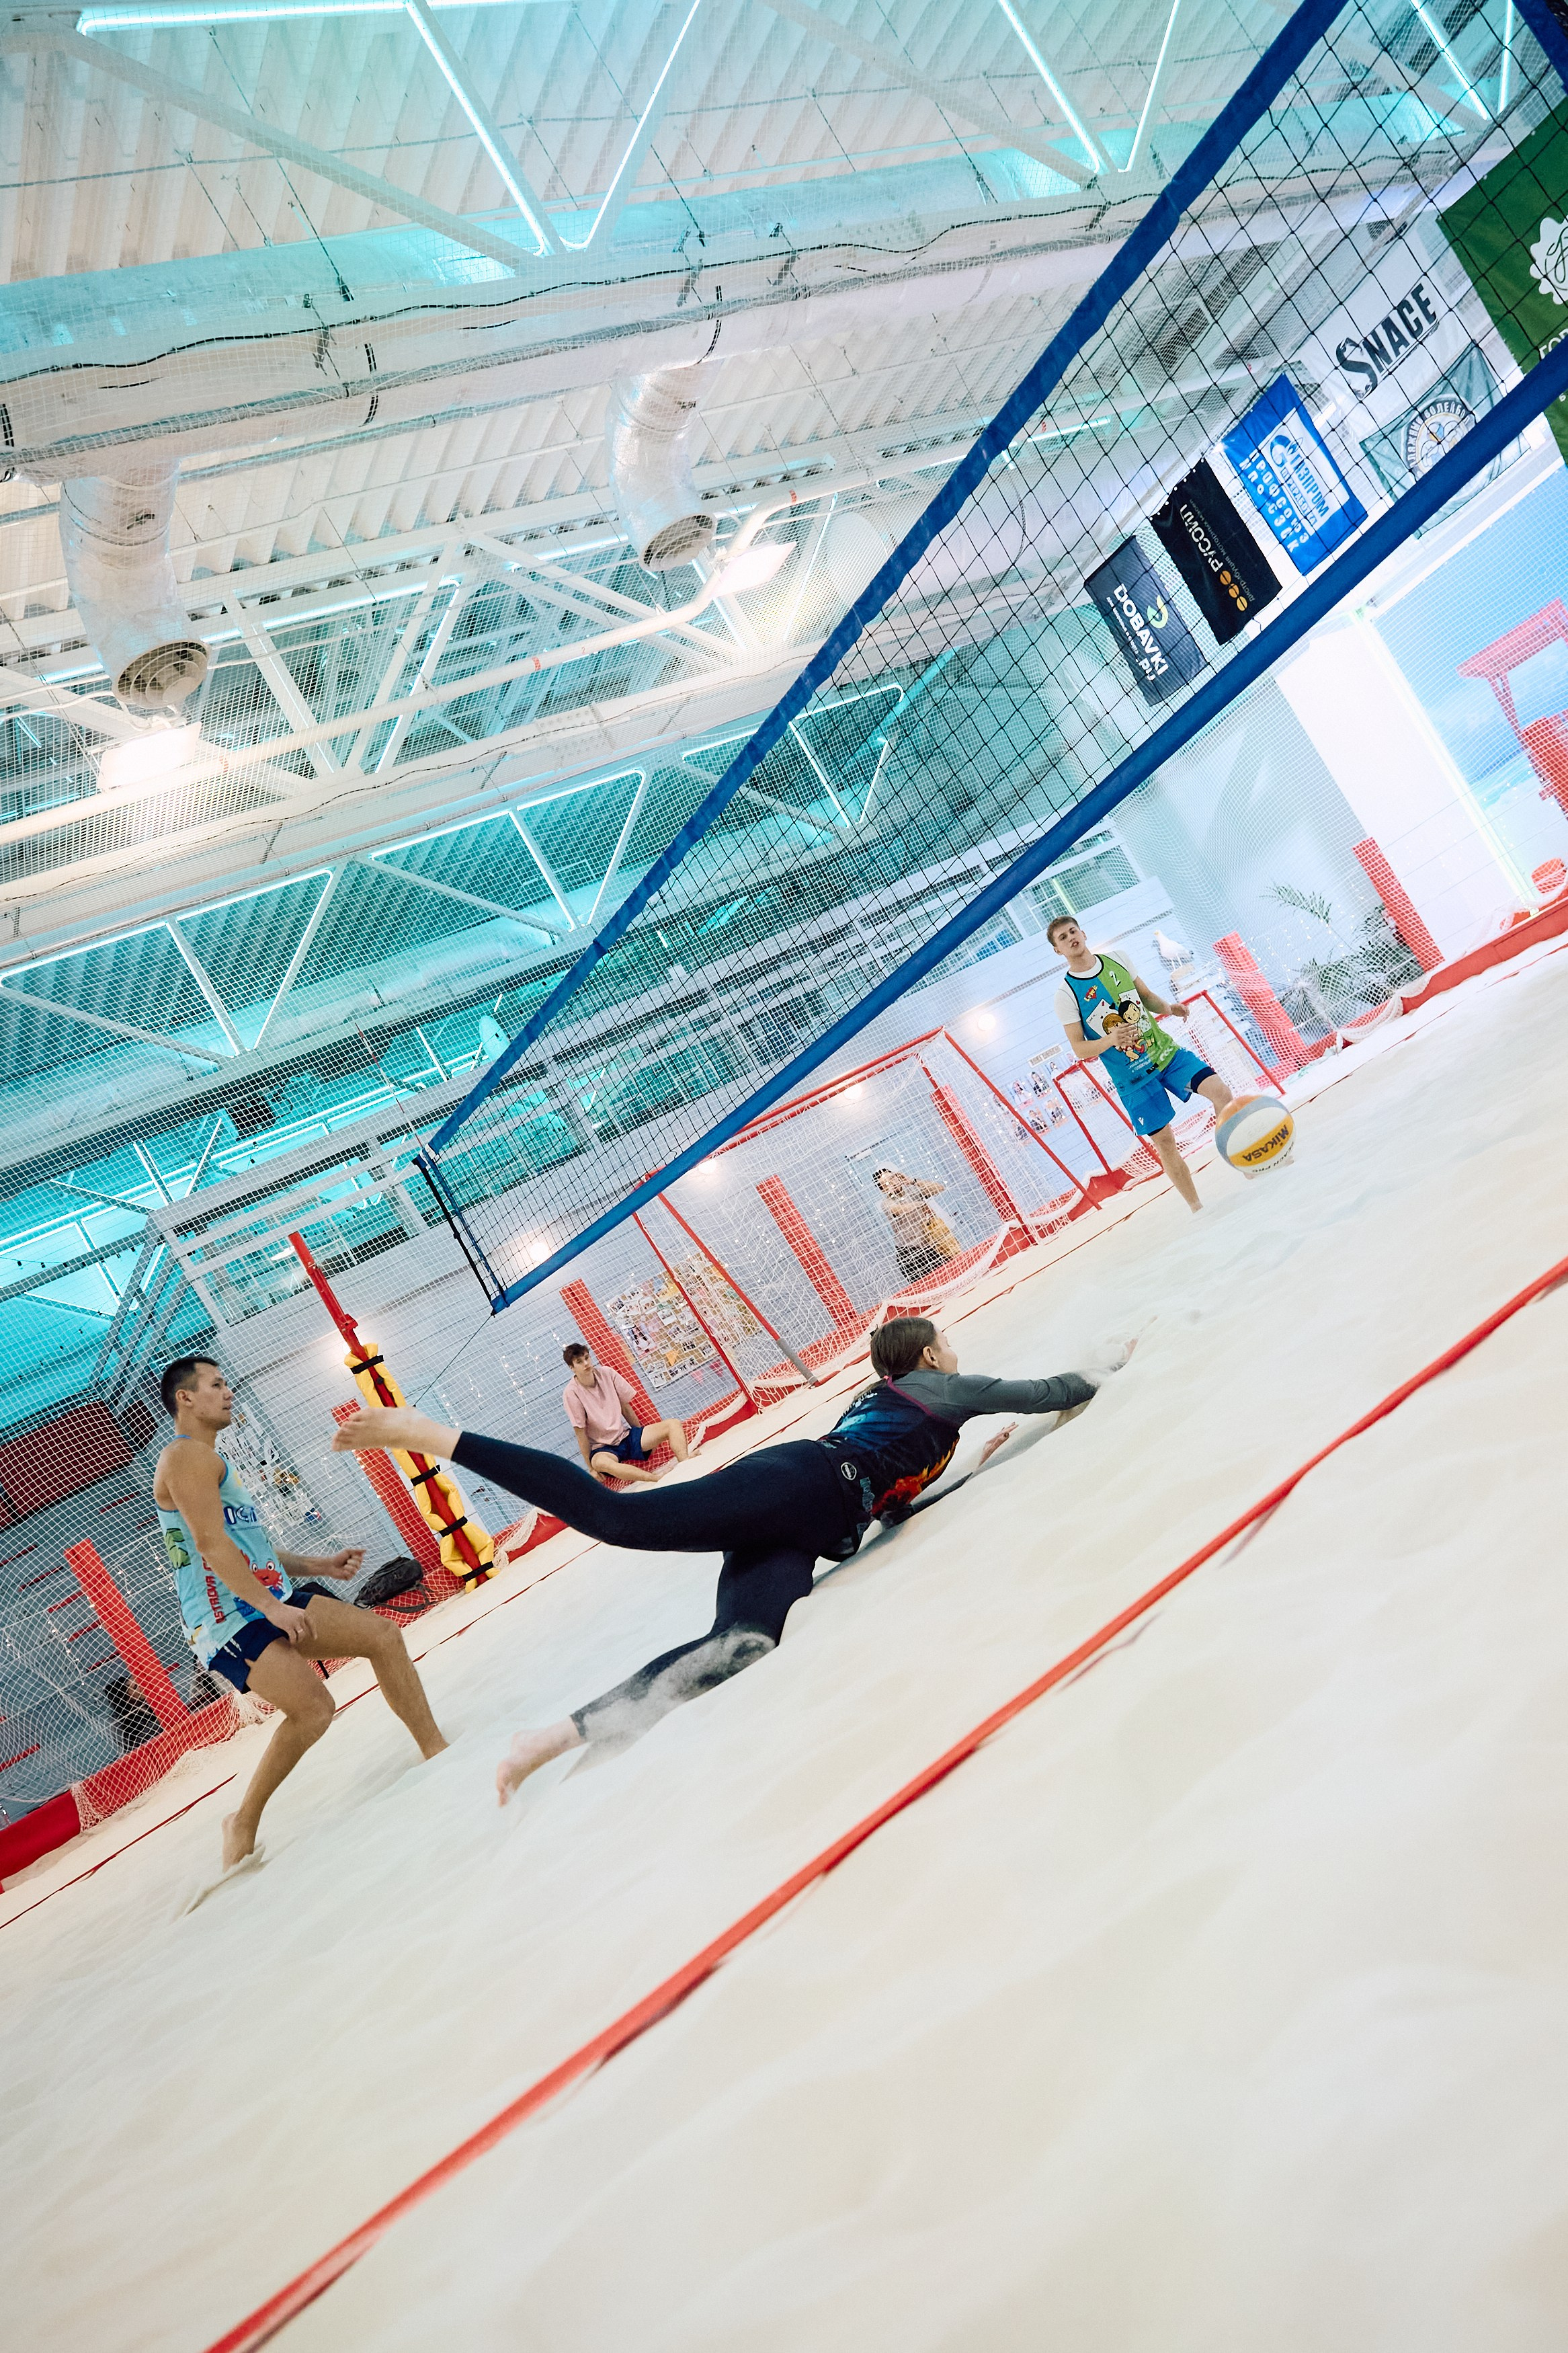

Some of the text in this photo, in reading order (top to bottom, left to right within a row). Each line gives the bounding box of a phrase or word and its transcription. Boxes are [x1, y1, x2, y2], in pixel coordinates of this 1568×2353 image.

[1336, 283, 1437, 399] SNACE
[1249, 448, 1309, 543] ПРОФСОЮЗ
[1290, 453, 1329, 518] ГАЗПРОМ
[1180, 504, 1224, 572] РУСОИЛ
[1113, 583, 1169, 676] DOBAVKI
[1109, 970, 1121, 987] 2
